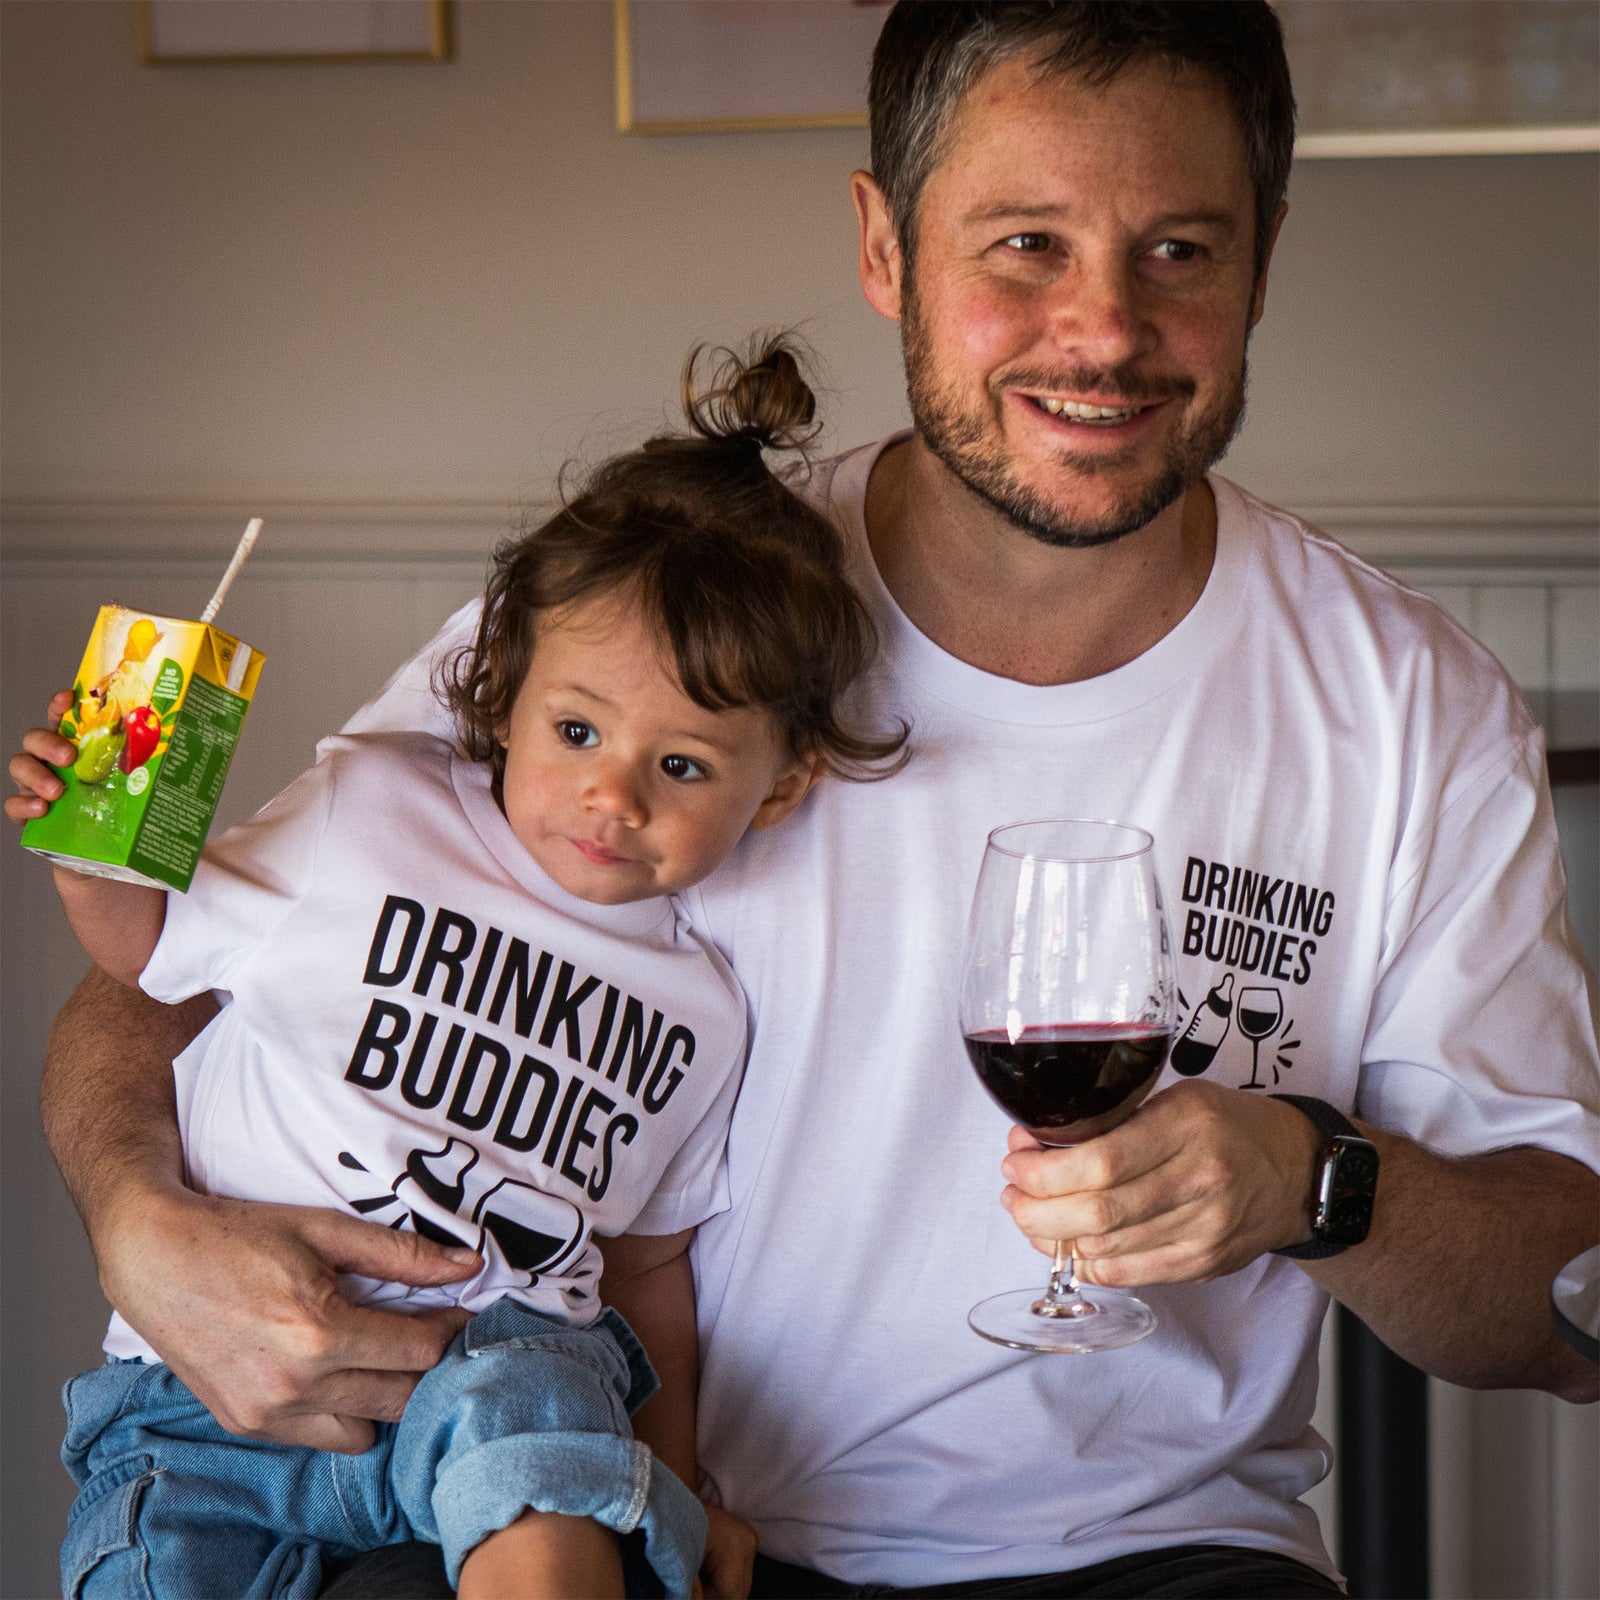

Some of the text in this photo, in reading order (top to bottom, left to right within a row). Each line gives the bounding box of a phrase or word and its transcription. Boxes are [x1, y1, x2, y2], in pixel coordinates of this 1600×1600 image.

[1181, 856, 1335, 937] DRINKING
[1182, 909, 1317, 986] BUDDIES
[362, 894, 696, 1115] DRINKING
[344, 998, 639, 1202] BUDDIES
